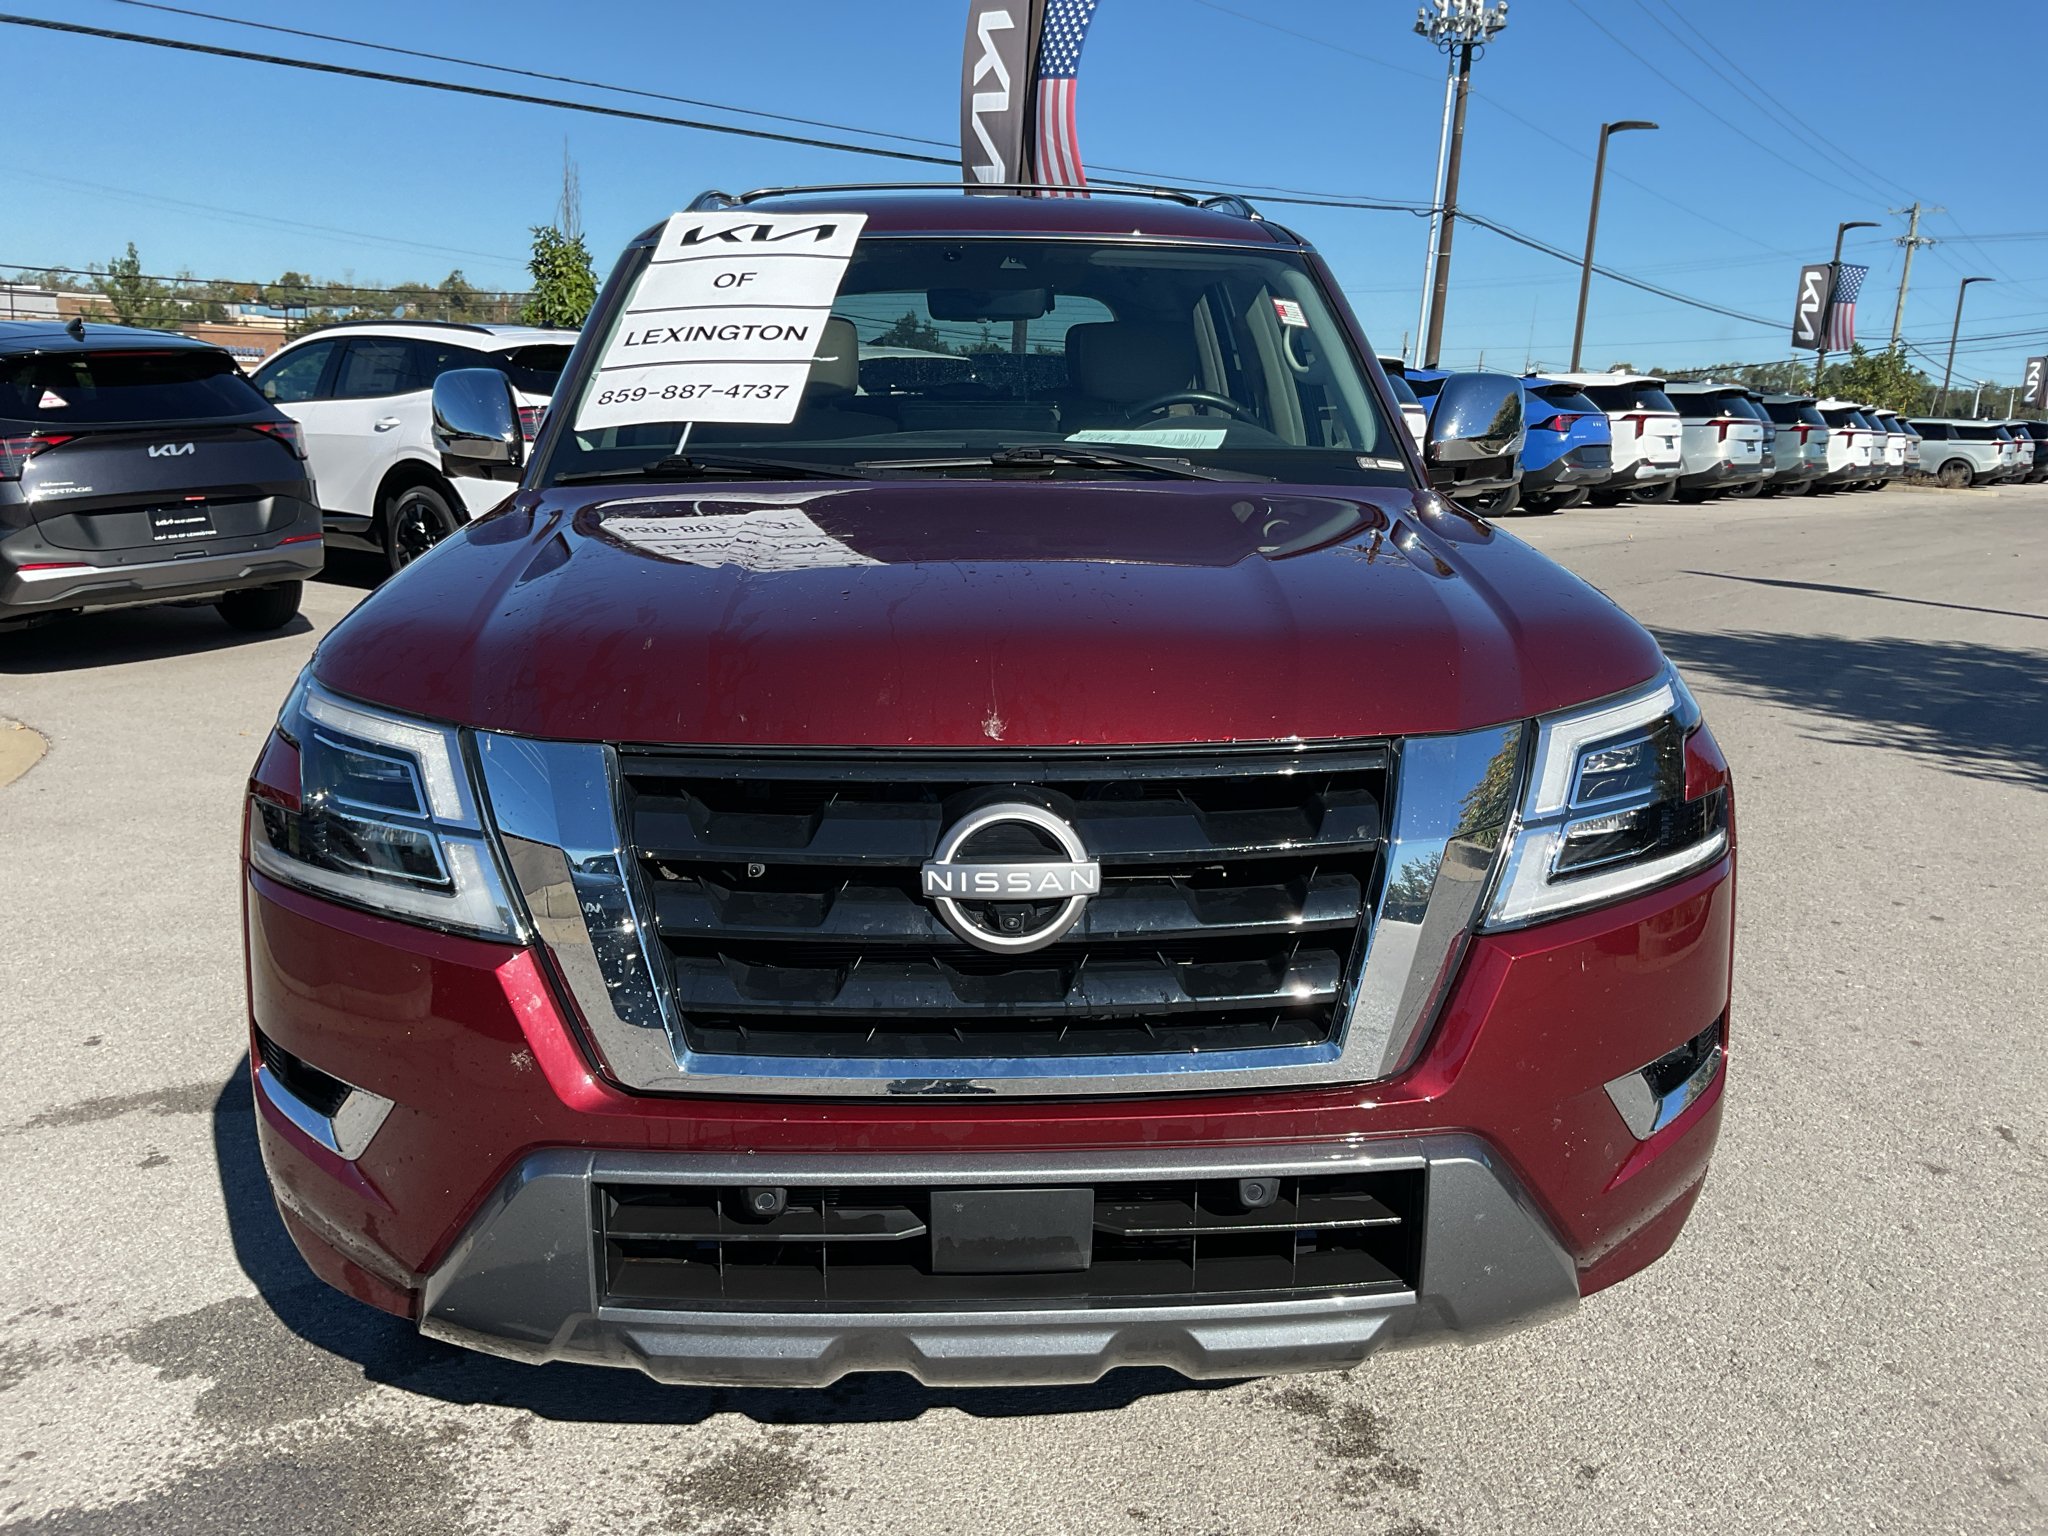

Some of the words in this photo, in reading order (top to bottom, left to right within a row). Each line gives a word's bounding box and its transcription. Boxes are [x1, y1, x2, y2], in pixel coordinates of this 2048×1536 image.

[971, 10, 1015, 184] KIA
[679, 223, 839, 247] KIA
[712, 271, 758, 289] OF
[623, 324, 810, 347] LEXINGTON
[597, 384, 790, 405] 859-887-4737
[147, 442, 195, 458] KIA
[927, 869, 1094, 892] NISSAN
